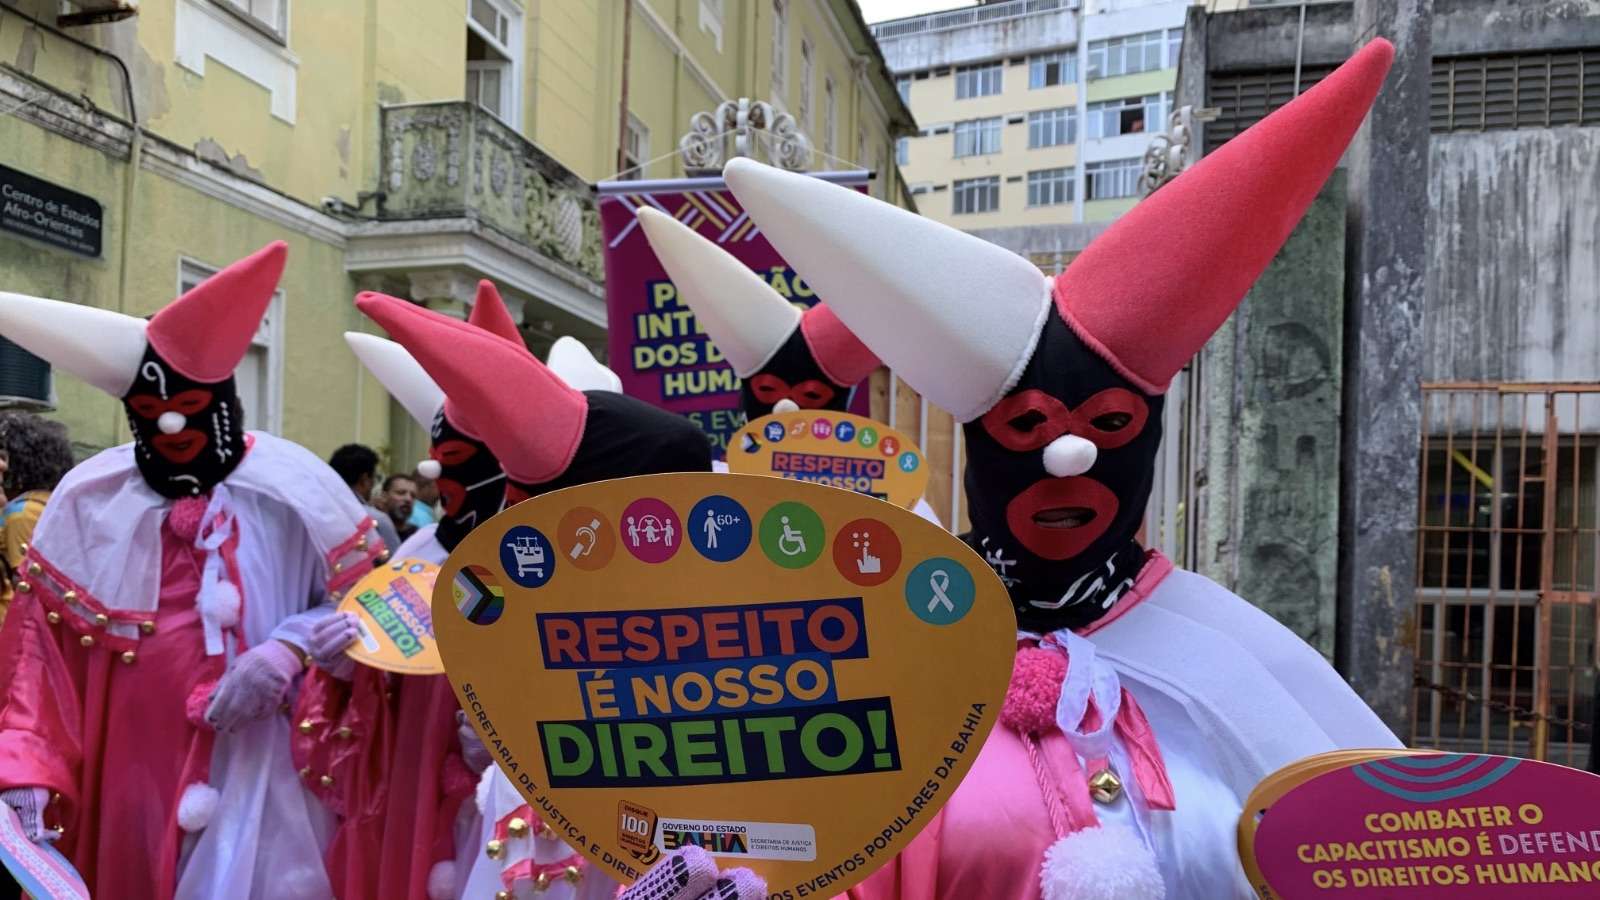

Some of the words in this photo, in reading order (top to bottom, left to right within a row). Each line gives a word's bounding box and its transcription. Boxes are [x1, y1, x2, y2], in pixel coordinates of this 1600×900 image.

[2, 184, 43, 208] Centro
[45, 200, 58, 214] de
[61, 204, 99, 228] Estudos
[634, 343, 698, 369] DOS
[774, 454, 883, 477] RESPEITO
[717, 514, 740, 525] 60+
[543, 605, 858, 662] RESPEITO
[585, 670, 621, 718] É
[631, 660, 829, 716] NOSSO
[543, 710, 892, 777] DIREITO!
[462, 683, 518, 773] SECRETARIA
[518, 773, 537, 794] DE
[535, 796, 586, 847] JUSTIÇA
[590, 843, 600, 856] E
[602, 855, 643, 880] DIREI
[796, 853, 865, 897] EVENTOS
[864, 779, 940, 858] POPULARES
[935, 756, 957, 779] DA
[950, 702, 987, 754] BAHIA
[621, 813, 649, 836] 100
[662, 822, 700, 832] GOVERNO
[716, 825, 746, 833] ESTADO
[1364, 806, 1513, 833] COMBATER
[1518, 804, 1544, 825] O
[1297, 836, 1471, 864] CAPACITISMO
[1476, 832, 1494, 856] É
[1312, 867, 1347, 889] OS
[1351, 864, 1470, 888] DIREITOS
